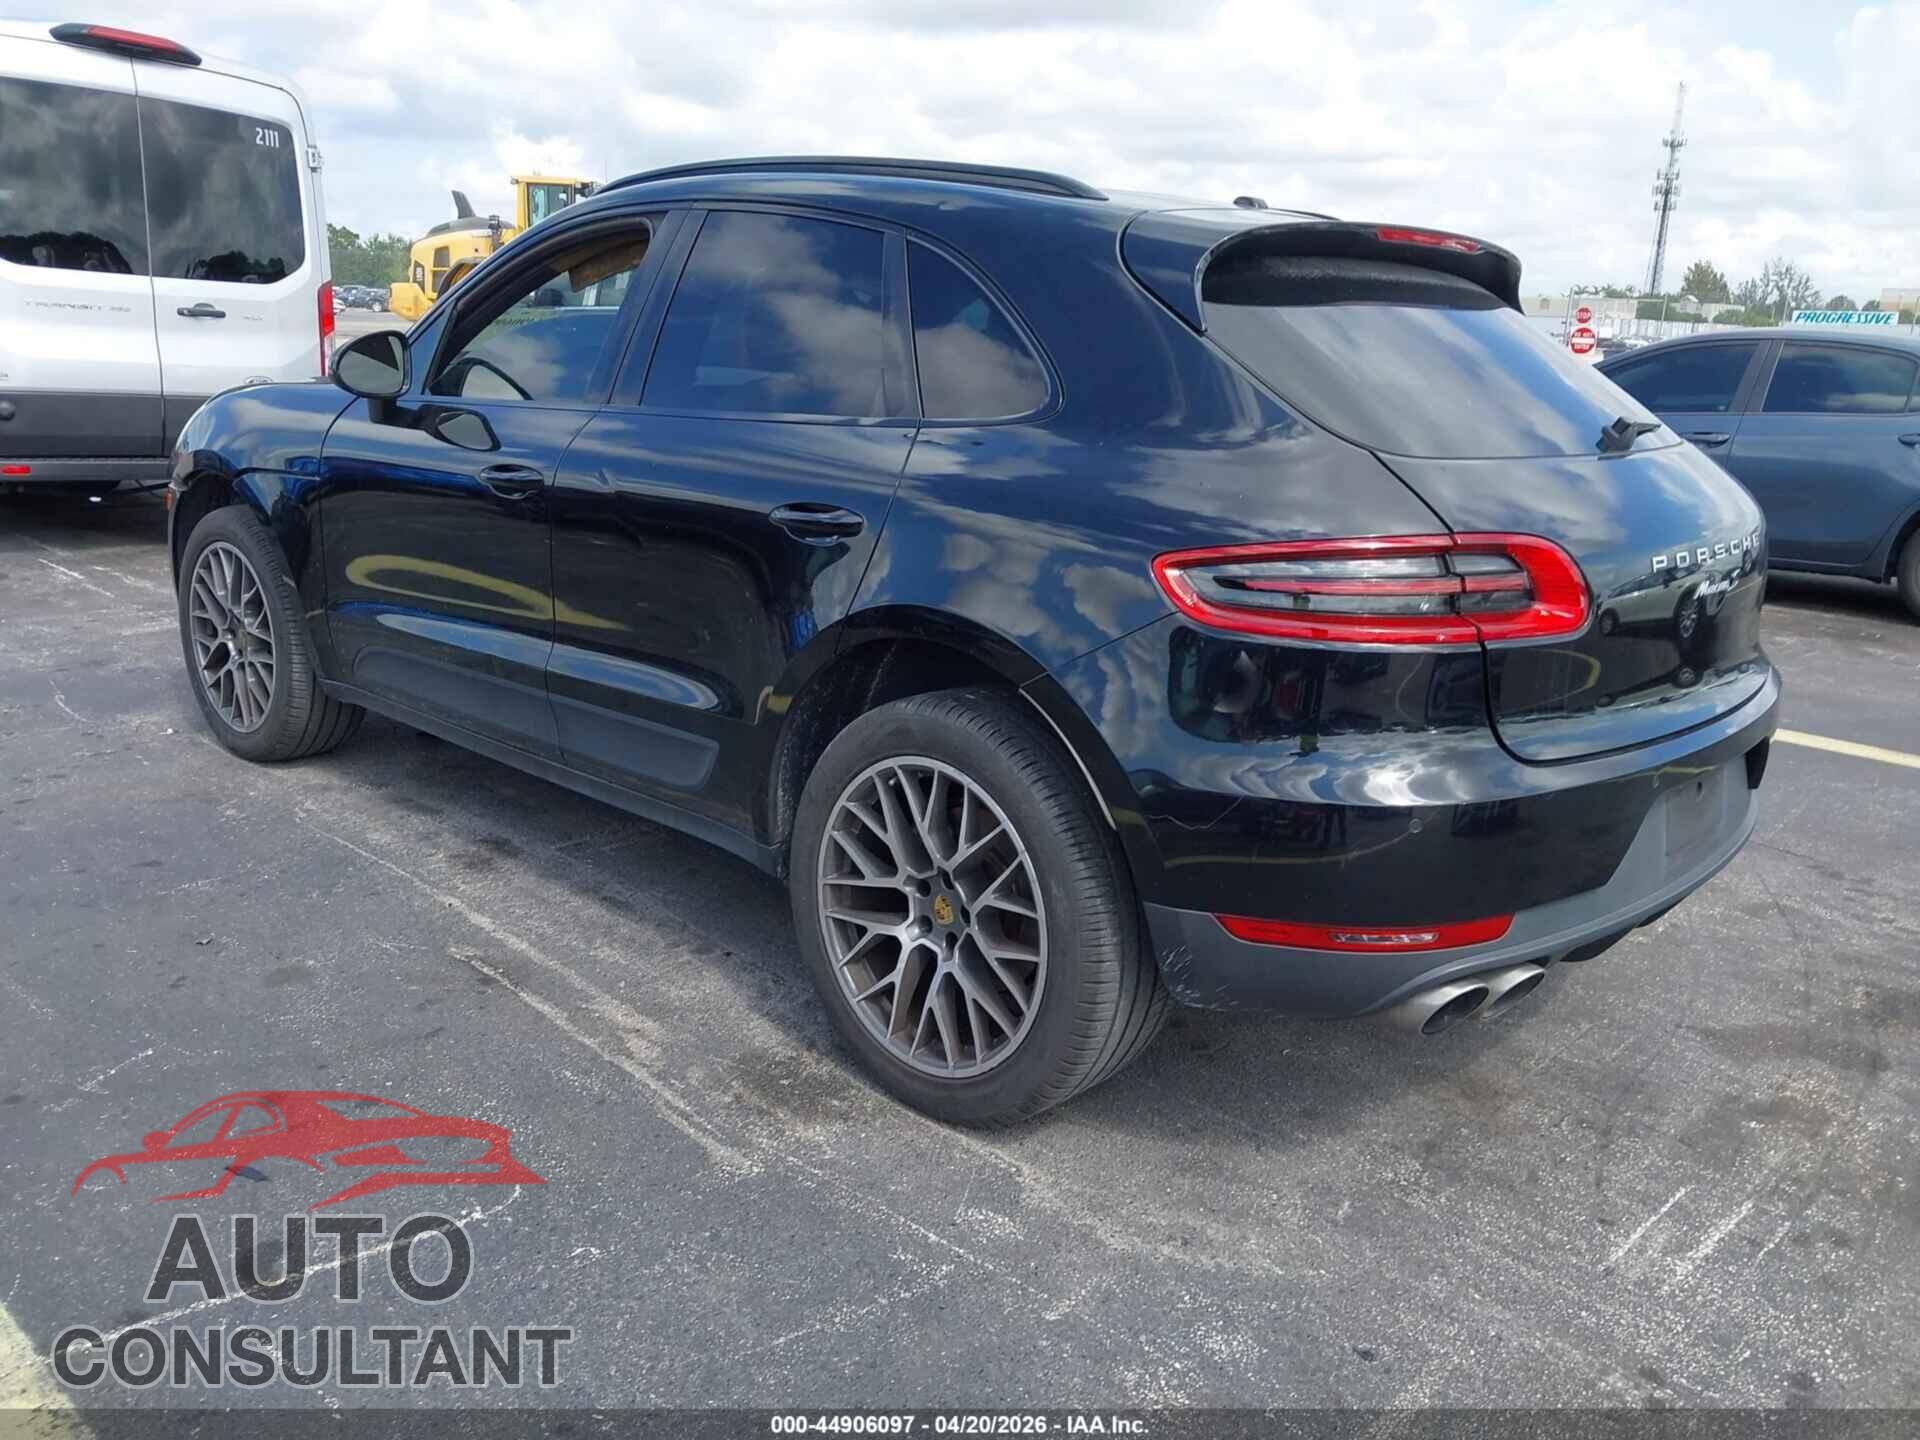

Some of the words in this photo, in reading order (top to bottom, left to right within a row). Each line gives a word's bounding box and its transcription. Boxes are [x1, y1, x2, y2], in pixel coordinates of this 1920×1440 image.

[255, 127, 280, 148] 2111
[1796, 311, 1894, 324] PROGRESSIVE
[1652, 532, 1760, 573] PORSCHE
